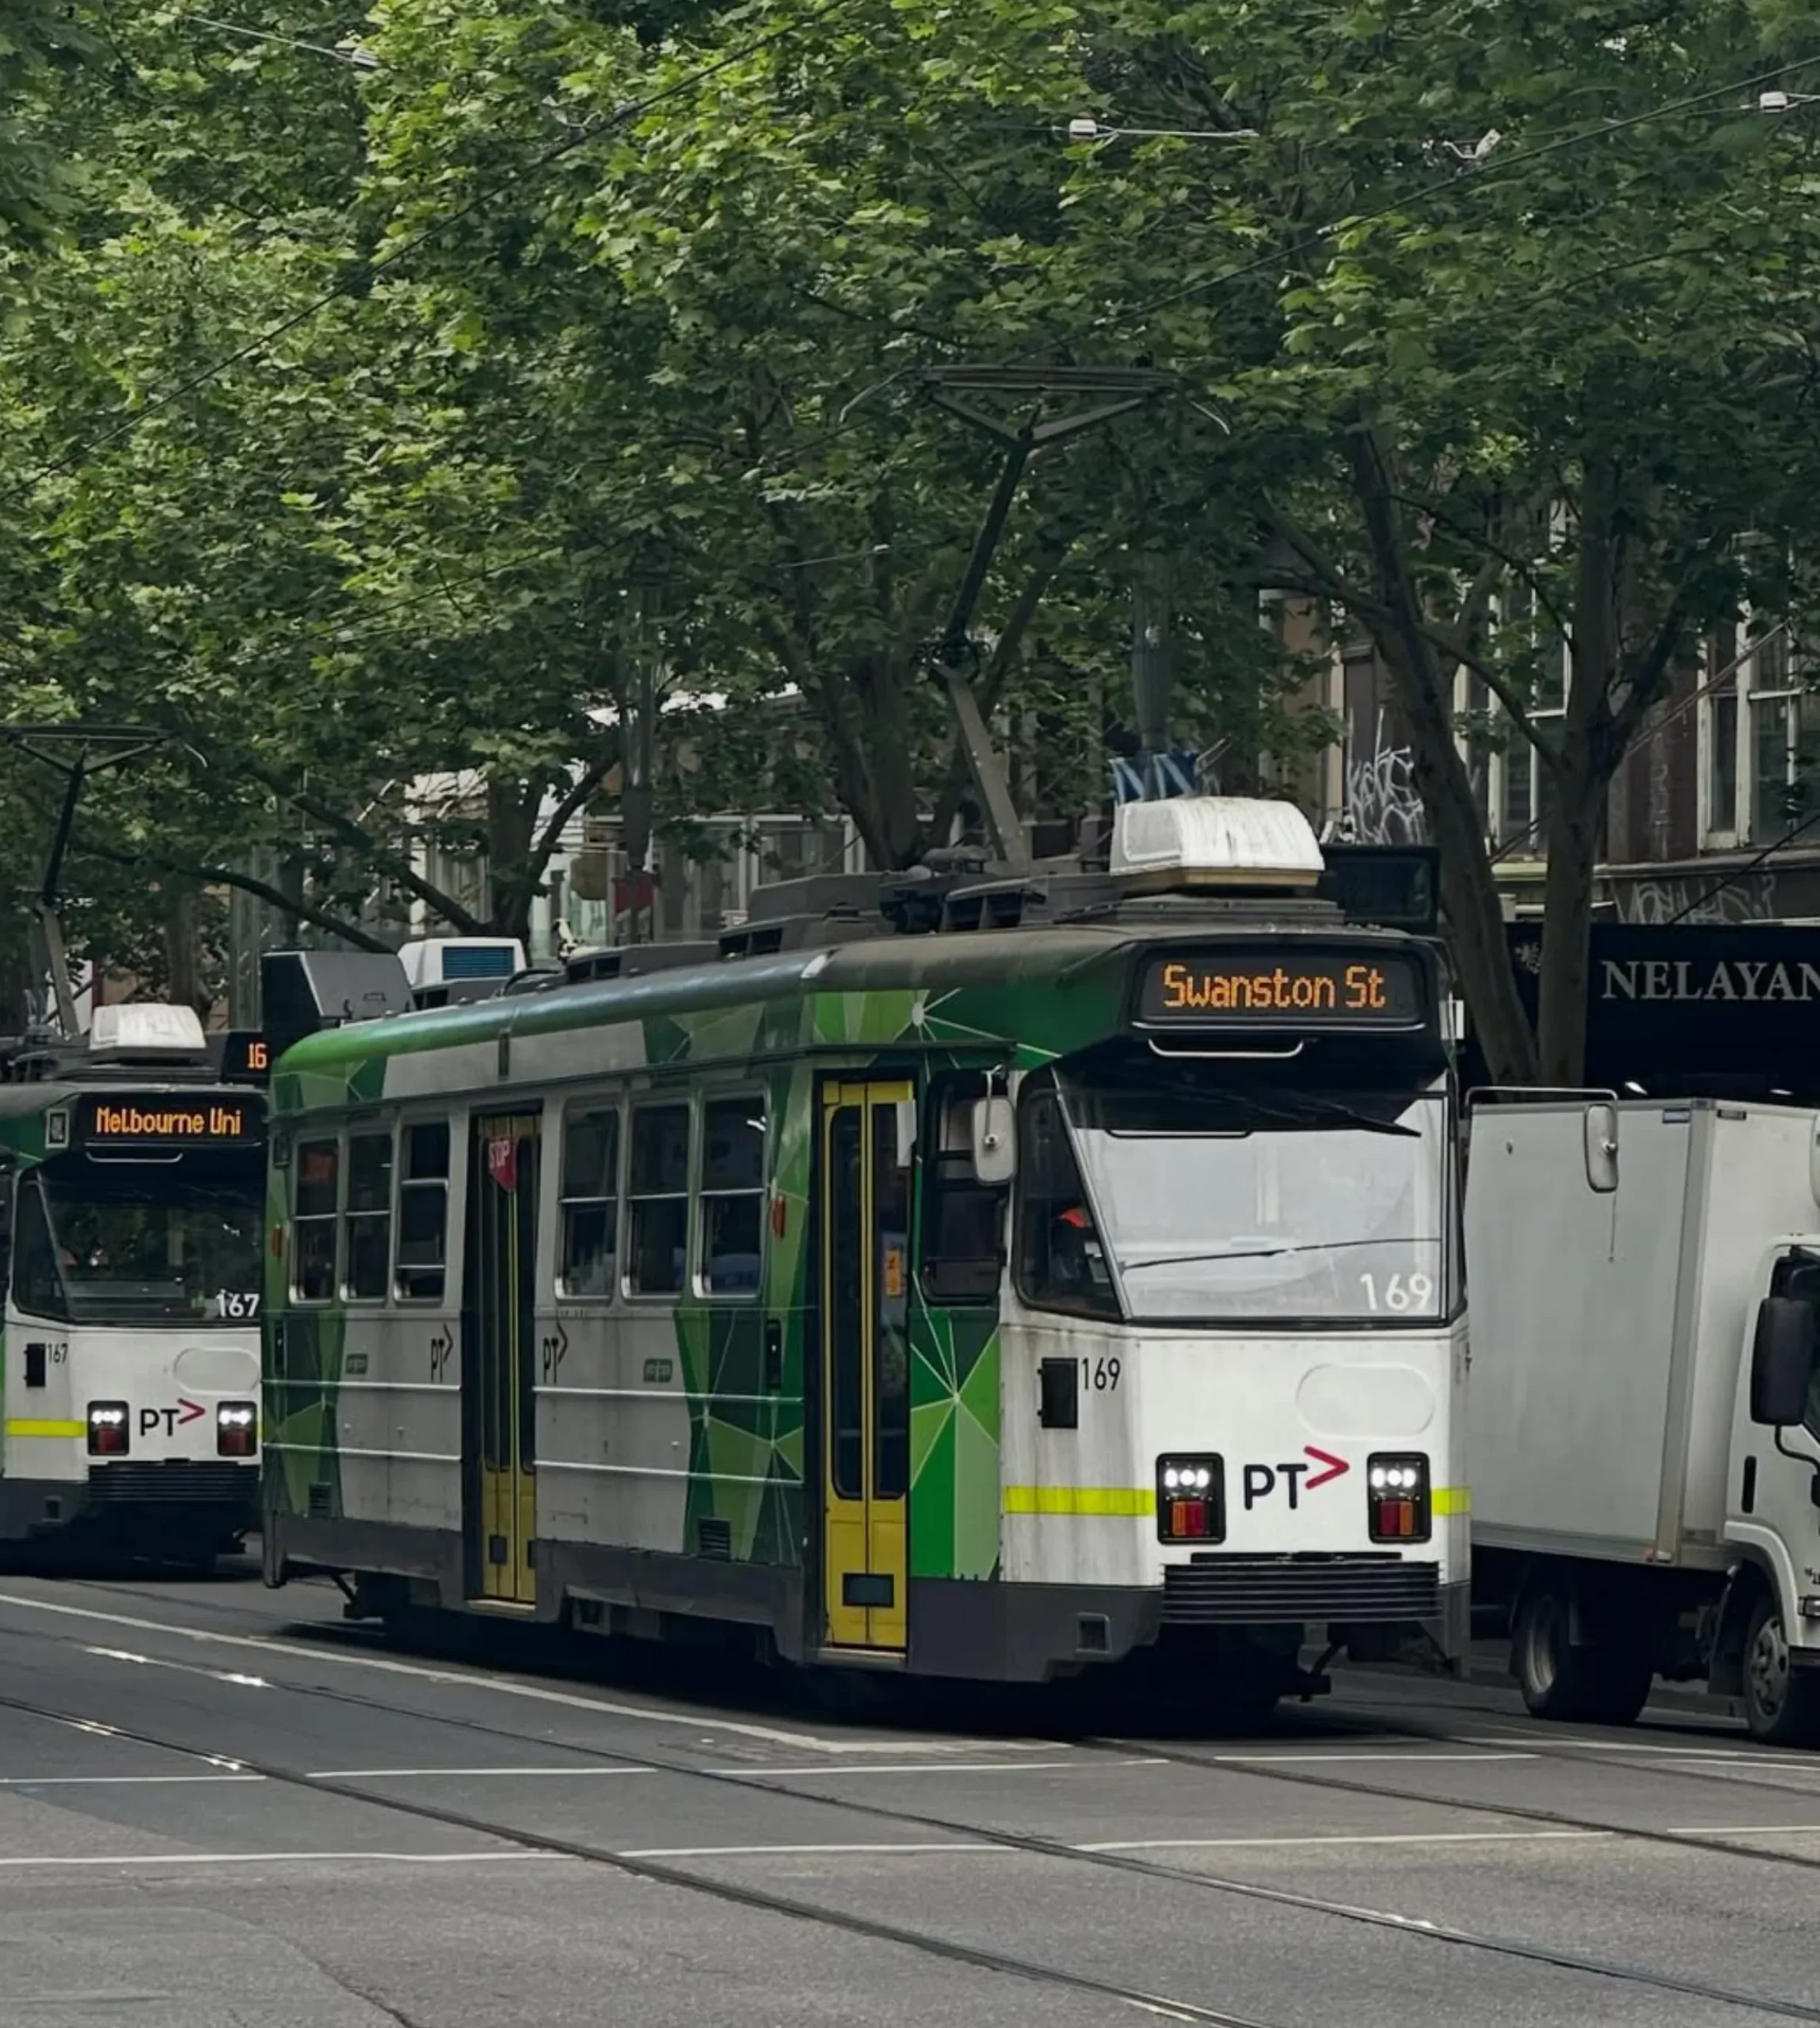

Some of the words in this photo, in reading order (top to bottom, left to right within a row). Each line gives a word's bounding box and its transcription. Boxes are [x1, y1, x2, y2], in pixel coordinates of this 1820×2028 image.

[1163, 964, 1336, 1008] Swanston
[1346, 966, 1385, 1008] St
[1601, 960, 1820, 1001] NELAYAN
[247, 1043, 267, 1069] 16
[97, 1107, 205, 1134] Melbourne
[209, 1107, 241, 1134] Uni
[215, 1290, 259, 1317] 167
[1360, 1273, 1432, 1310] 169
[48, 1344, 68, 1363] 167
[1081, 1357, 1121, 1391] 169
